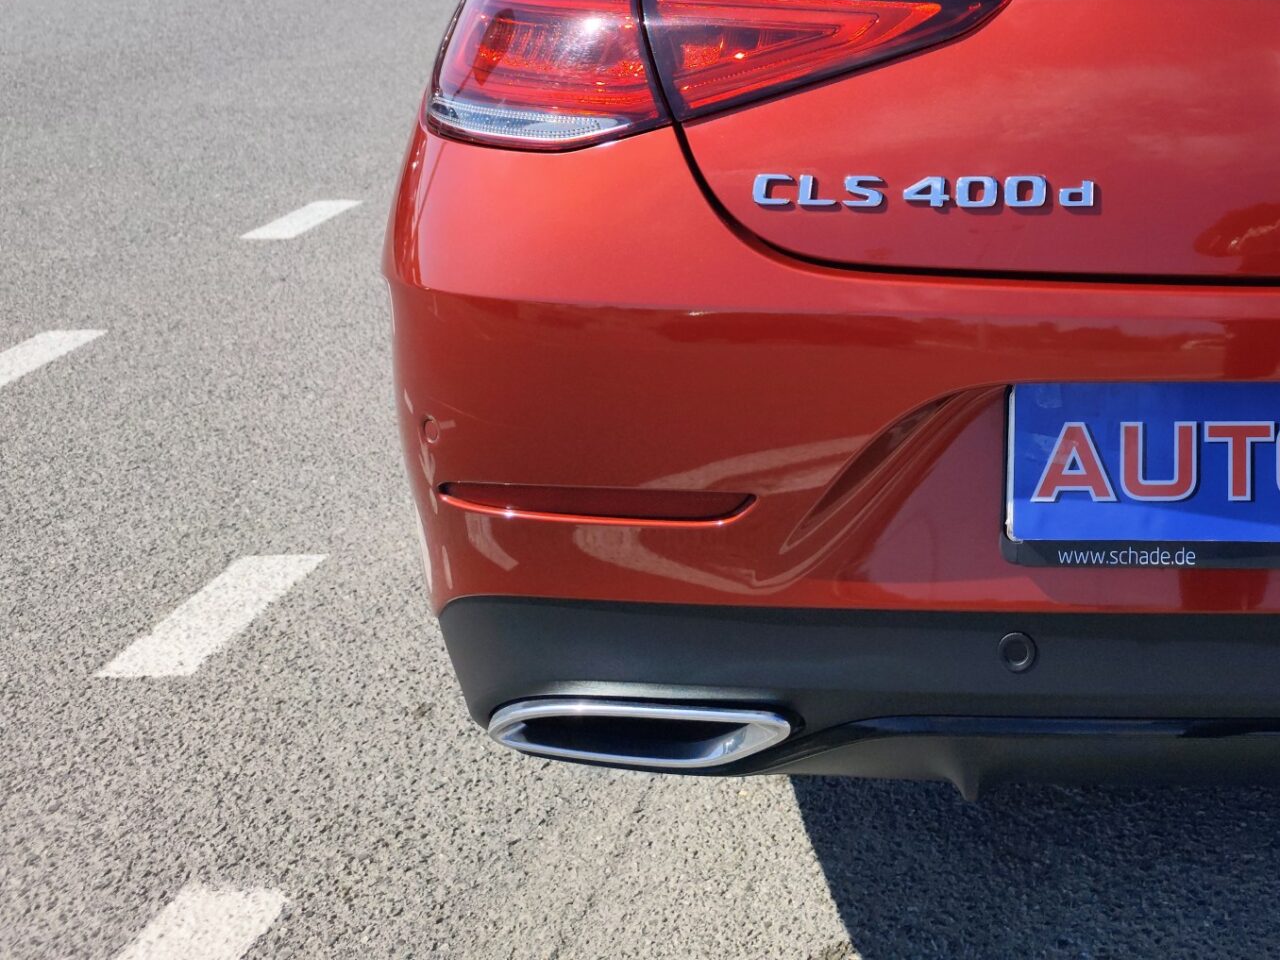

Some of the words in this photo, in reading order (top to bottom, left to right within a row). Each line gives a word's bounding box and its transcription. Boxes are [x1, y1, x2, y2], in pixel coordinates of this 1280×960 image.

[752, 173, 886, 207] CLS
[903, 175, 1046, 208] 400
[1058, 180, 1094, 207] d
[1058, 547, 1196, 566] www.schade.de
